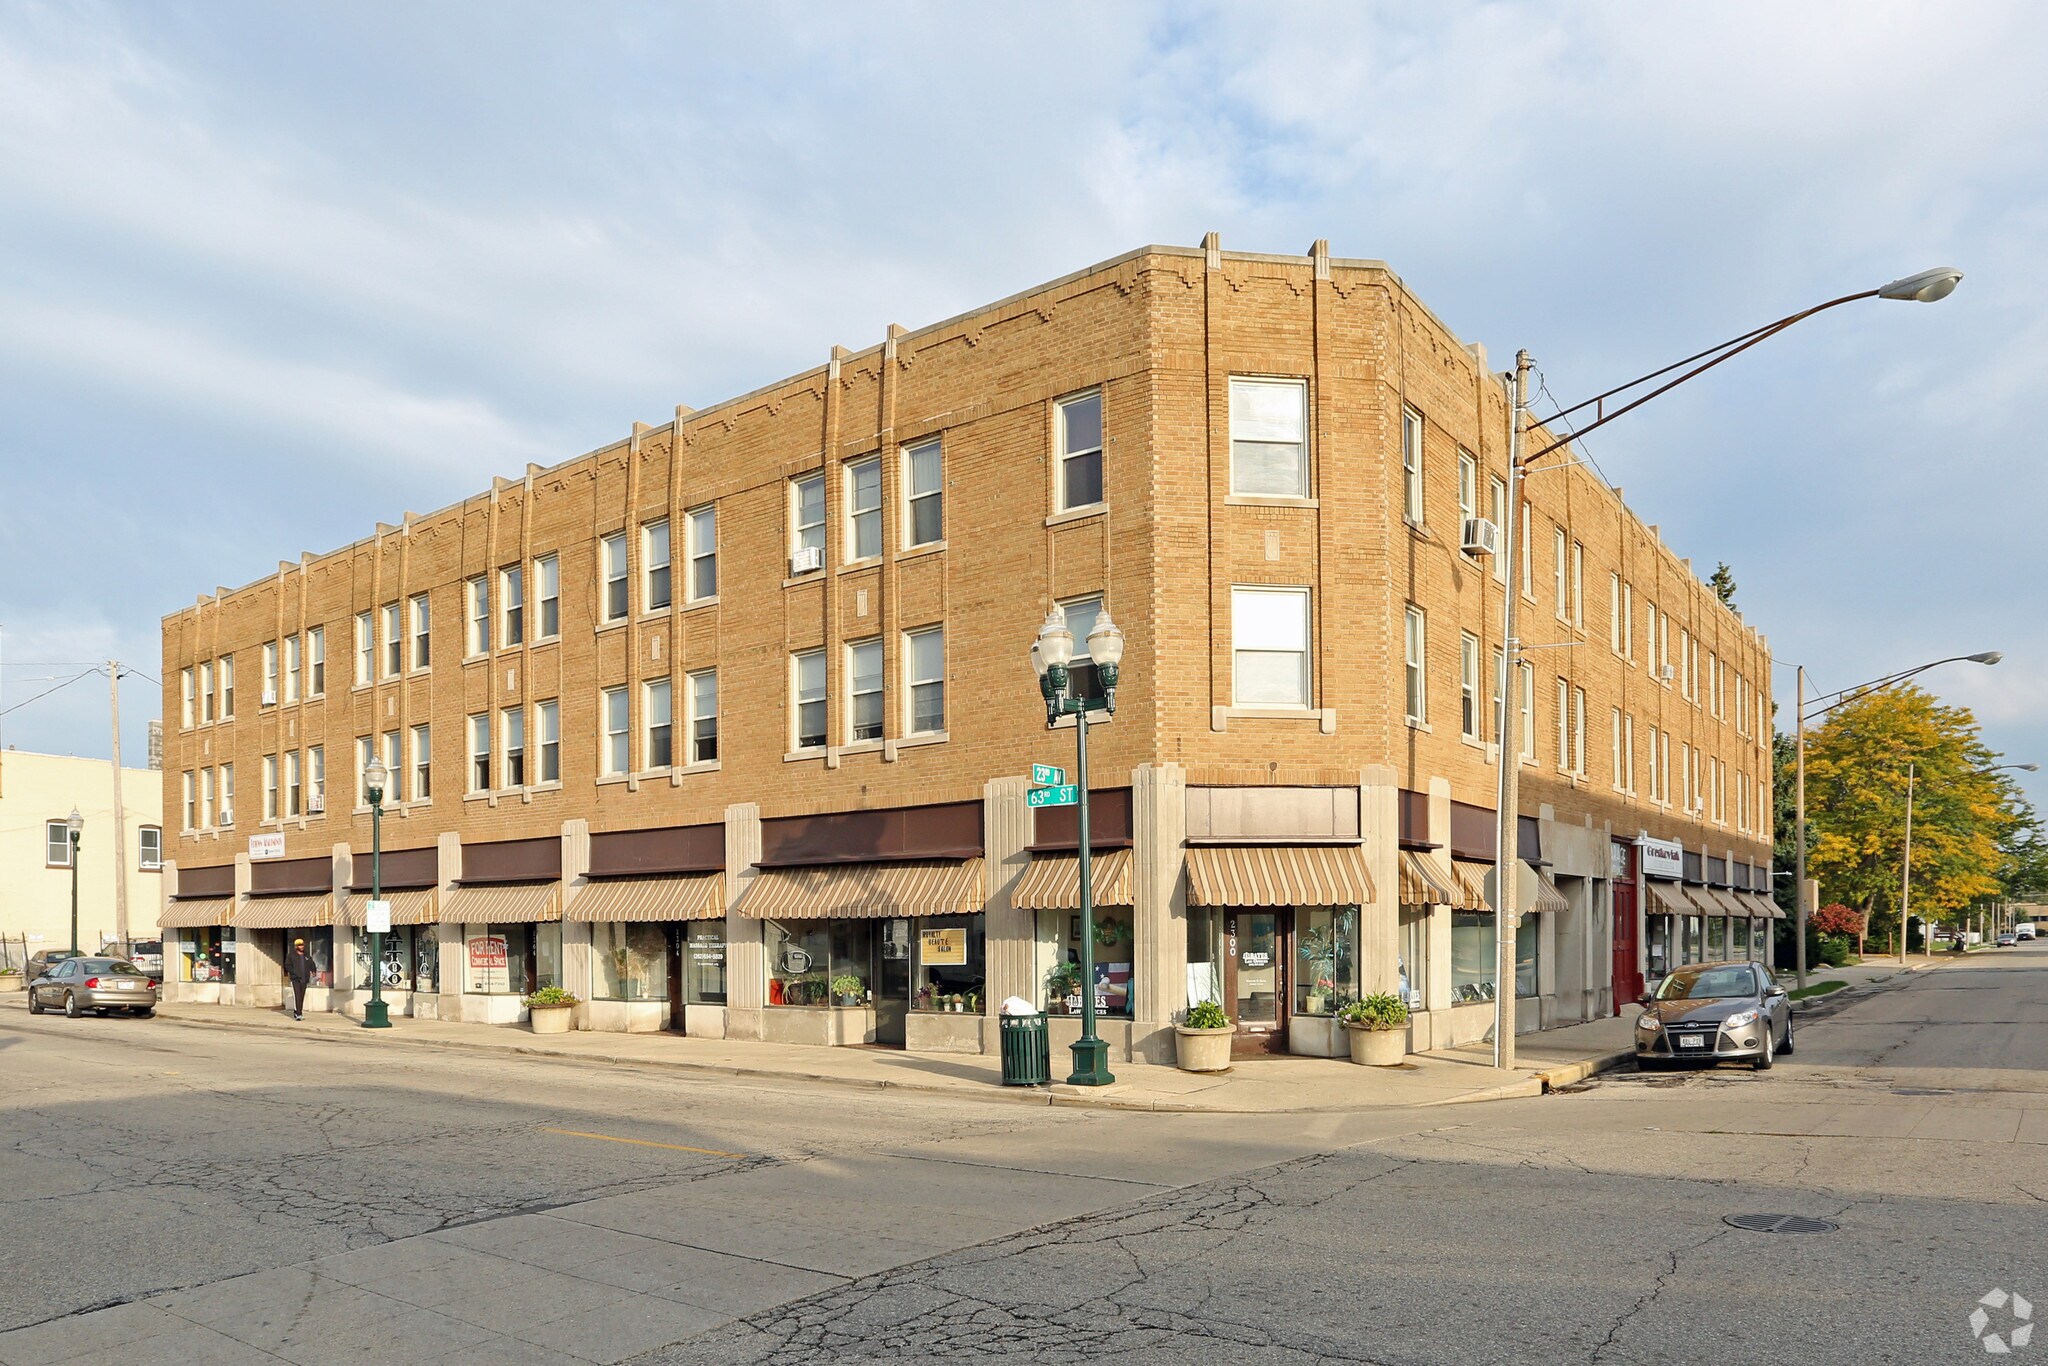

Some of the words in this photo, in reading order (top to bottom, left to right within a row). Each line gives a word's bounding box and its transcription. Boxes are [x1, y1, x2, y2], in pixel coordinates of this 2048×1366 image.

[1031, 790, 1050, 804] 63RD
[1060, 788, 1073, 802] ST
[471, 942, 485, 955] FOR
[486, 940, 504, 955] RENT
[385, 930, 404, 985] ATTOO
